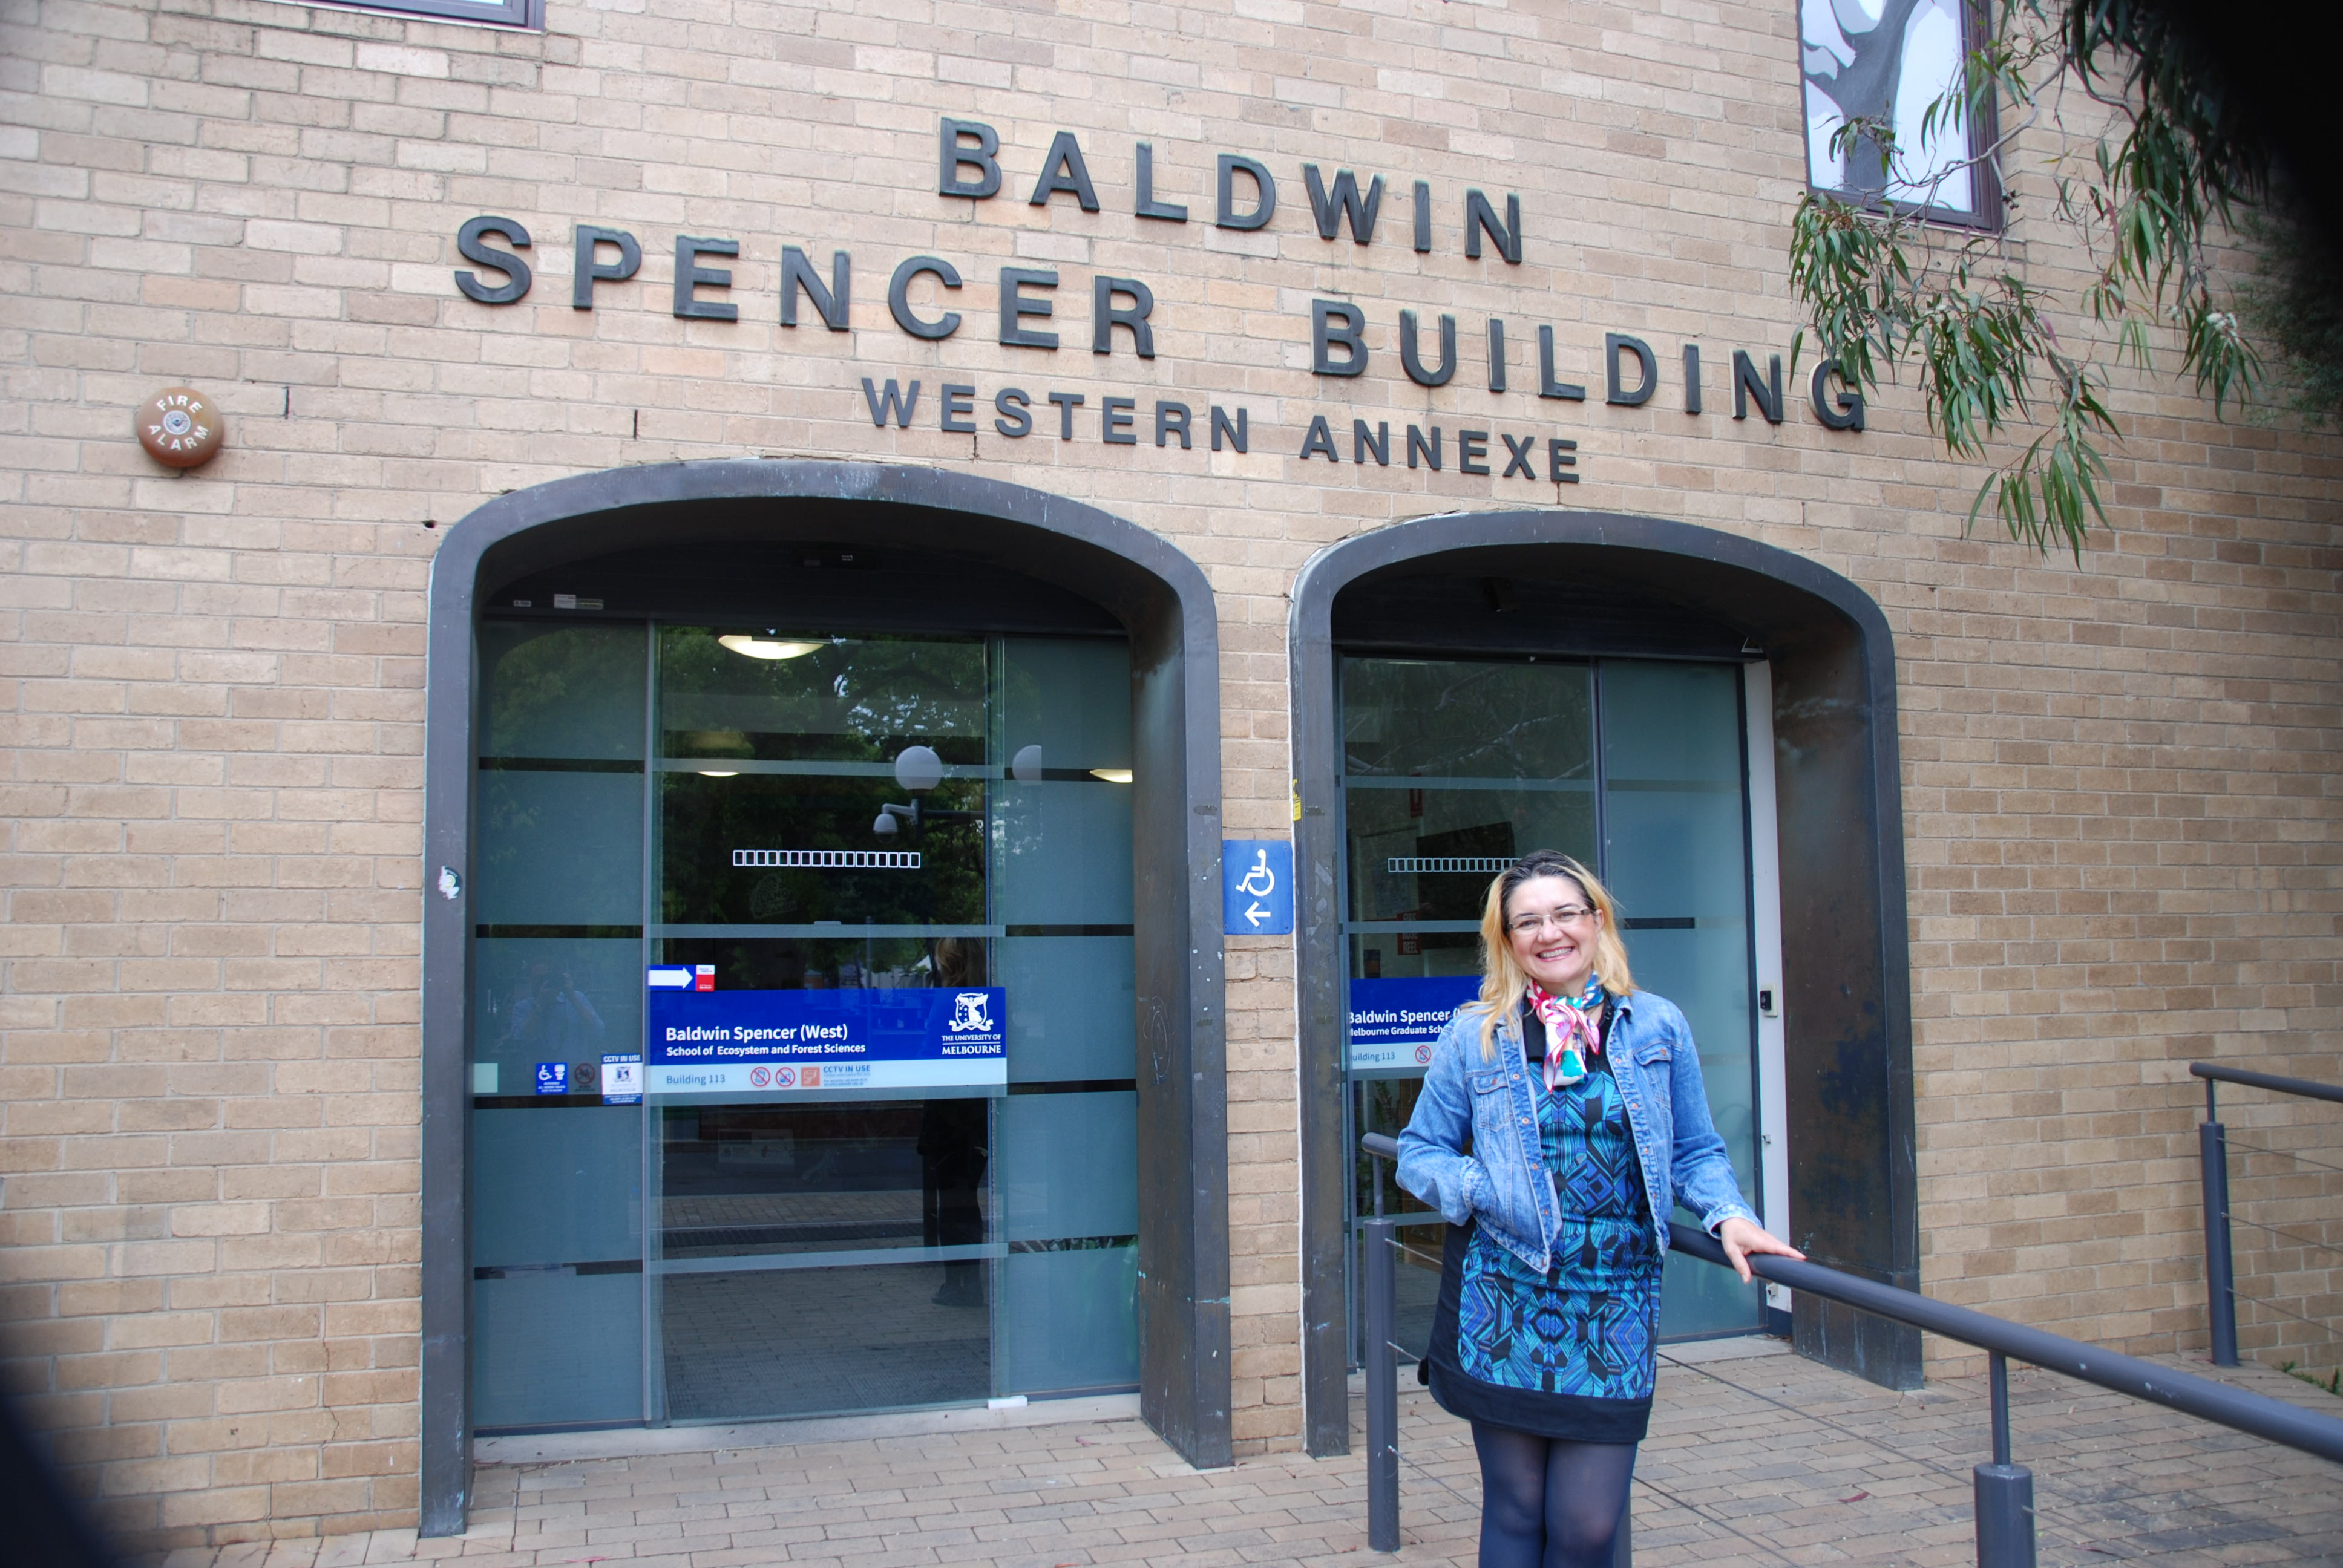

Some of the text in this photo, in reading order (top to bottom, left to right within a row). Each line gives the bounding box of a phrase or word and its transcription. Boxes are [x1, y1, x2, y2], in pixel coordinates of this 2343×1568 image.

[937, 116, 1522, 266] BALDWIN
[454, 215, 1866, 432] SPENCER BUILDING
[156, 394, 203, 414] FIRE
[149, 425, 209, 451] ALARM
[860, 377, 1580, 484] WESTERN ANNEXE
[1400, 1010, 1450, 1025] Spencer
[666, 1024, 848, 1043] Baldwin Spencer (West)
[1391, 1026, 1427, 1035] Graduate
[1428, 1025, 1443, 1034] Sch
[666, 1044, 866, 1057] School of Ecosystem and Forest Sciences
[942, 1045, 1001, 1055] MELBOURNE
[1352, 1051, 1395, 1062] uilding 113
[666, 1074, 726, 1085] Building 113
